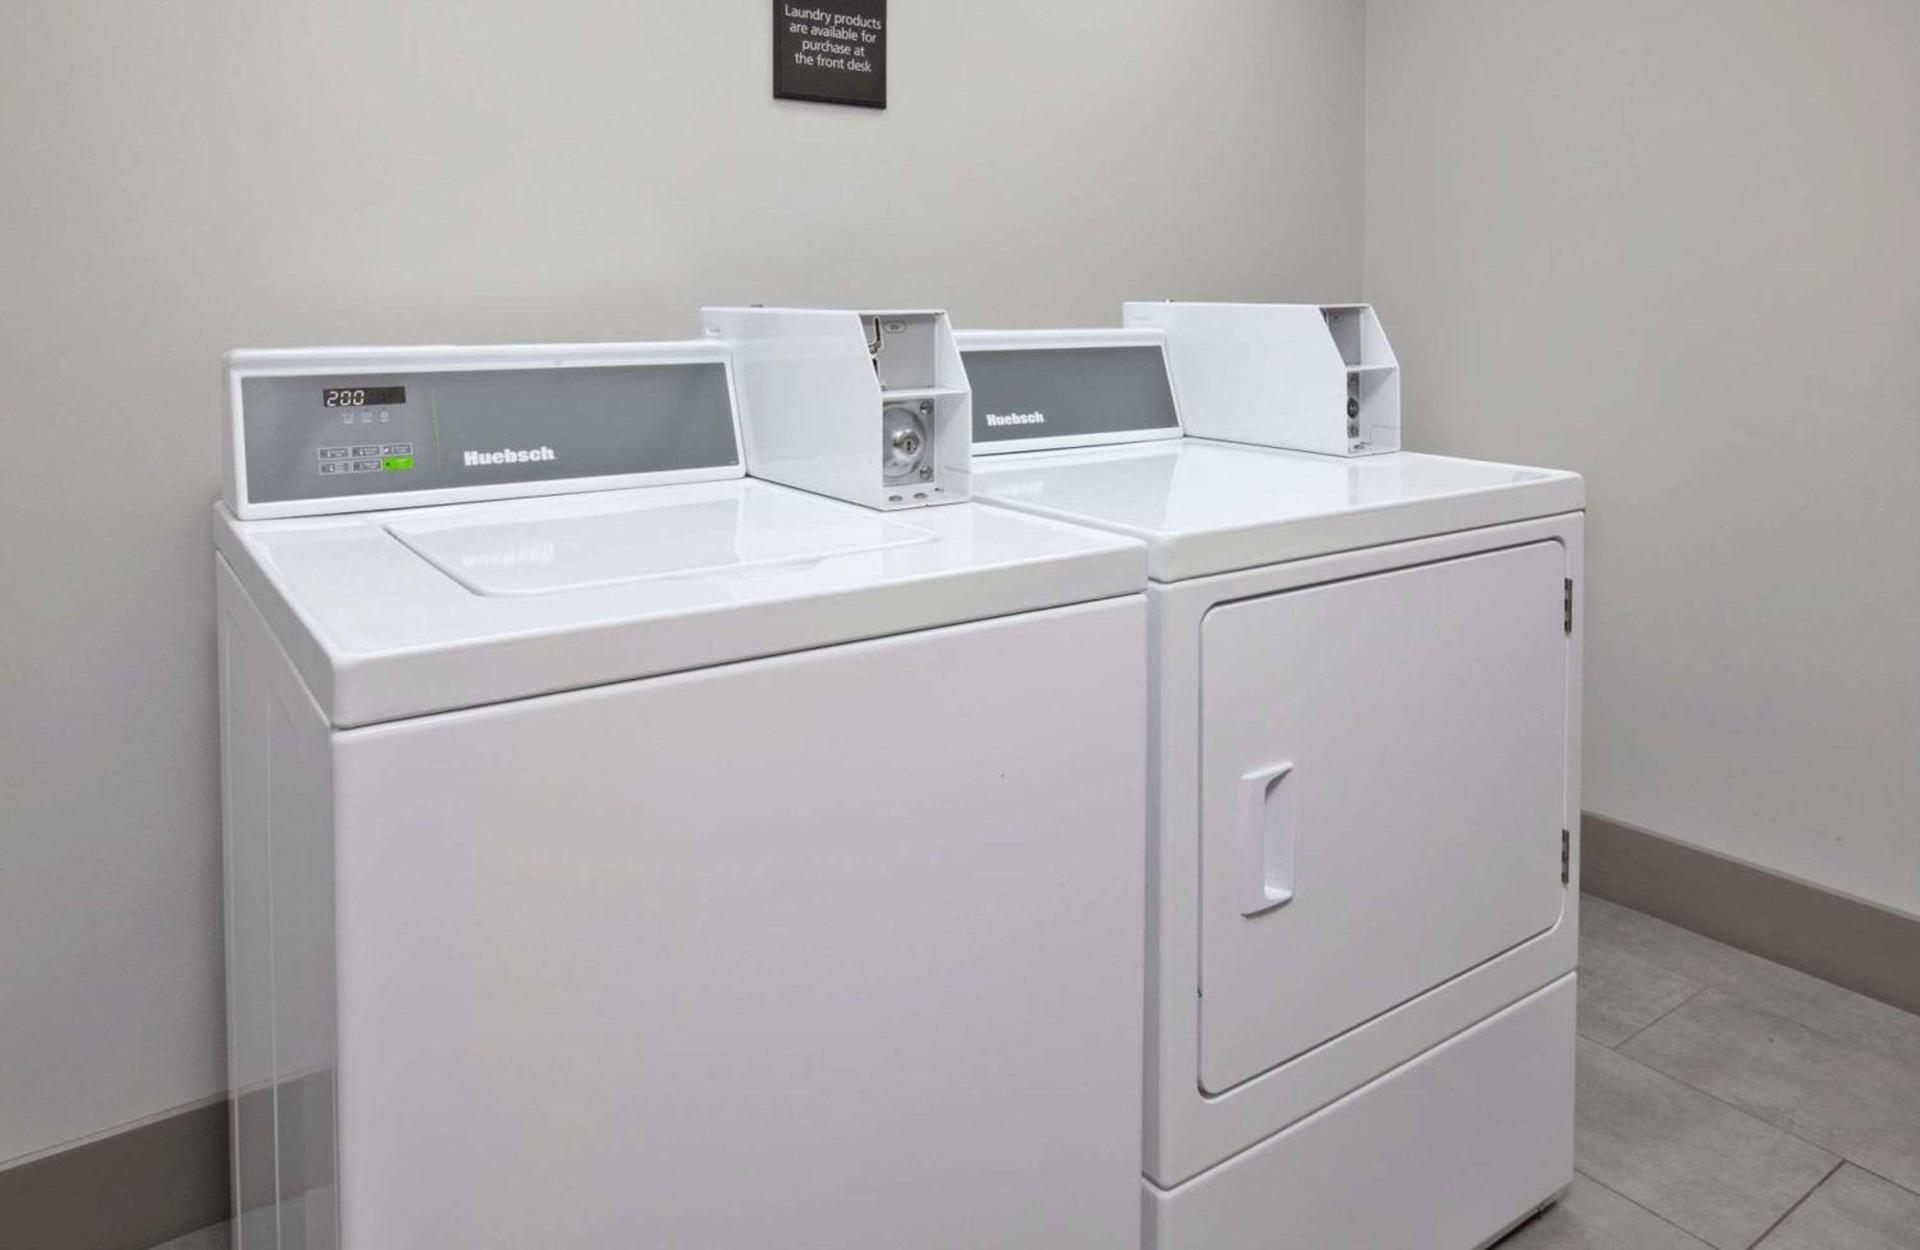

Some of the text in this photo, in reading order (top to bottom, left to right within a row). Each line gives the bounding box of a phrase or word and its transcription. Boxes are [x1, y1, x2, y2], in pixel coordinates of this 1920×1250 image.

[784, 4, 881, 30] Laundry products
[789, 22, 877, 43] are available for
[802, 40, 865, 57] purchase at
[794, 52, 872, 73] the front desk
[327, 390, 364, 407] 200
[986, 411, 1045, 426] Huebsch
[464, 446, 555, 466] Huebsch
